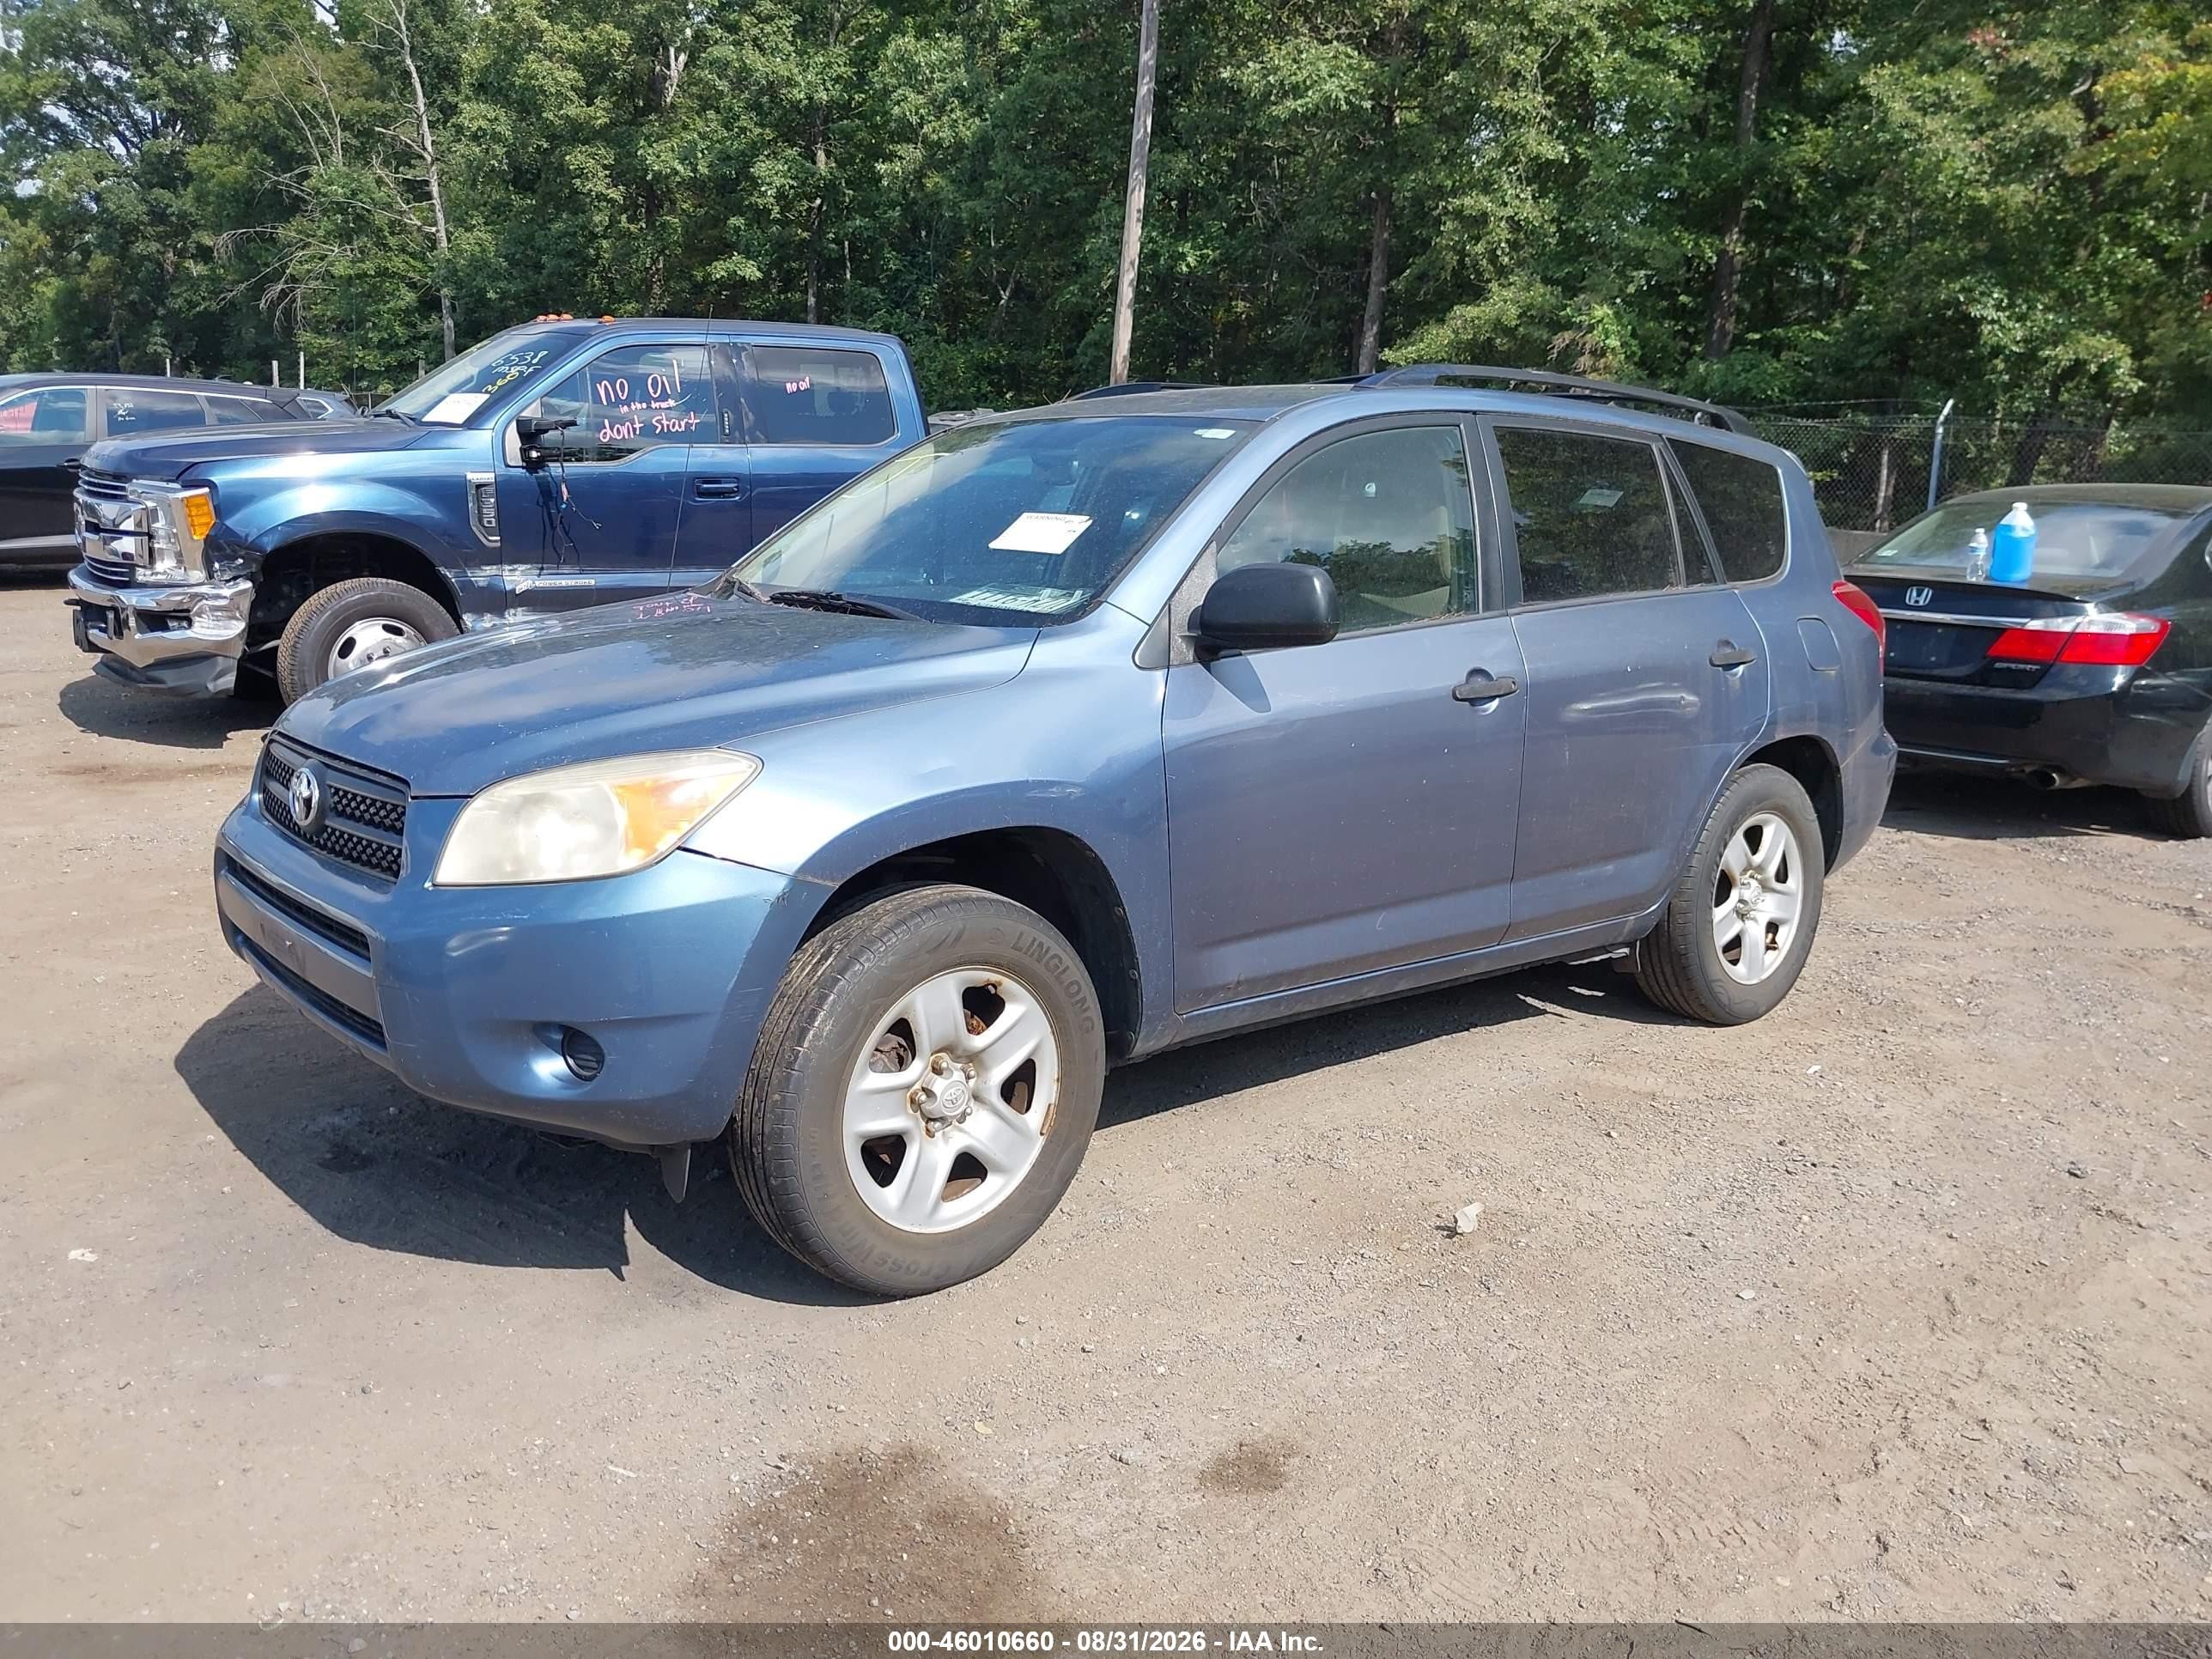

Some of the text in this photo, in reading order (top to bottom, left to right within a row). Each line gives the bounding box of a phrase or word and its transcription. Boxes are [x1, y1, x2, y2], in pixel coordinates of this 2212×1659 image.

[491, 350, 550, 368] 6538
[618, 398, 677, 414] in the truck
[652, 411, 701, 434] start
[1993, 662, 2041, 672] SPORT
[1011, 930, 1095, 1035] LINGLONG
